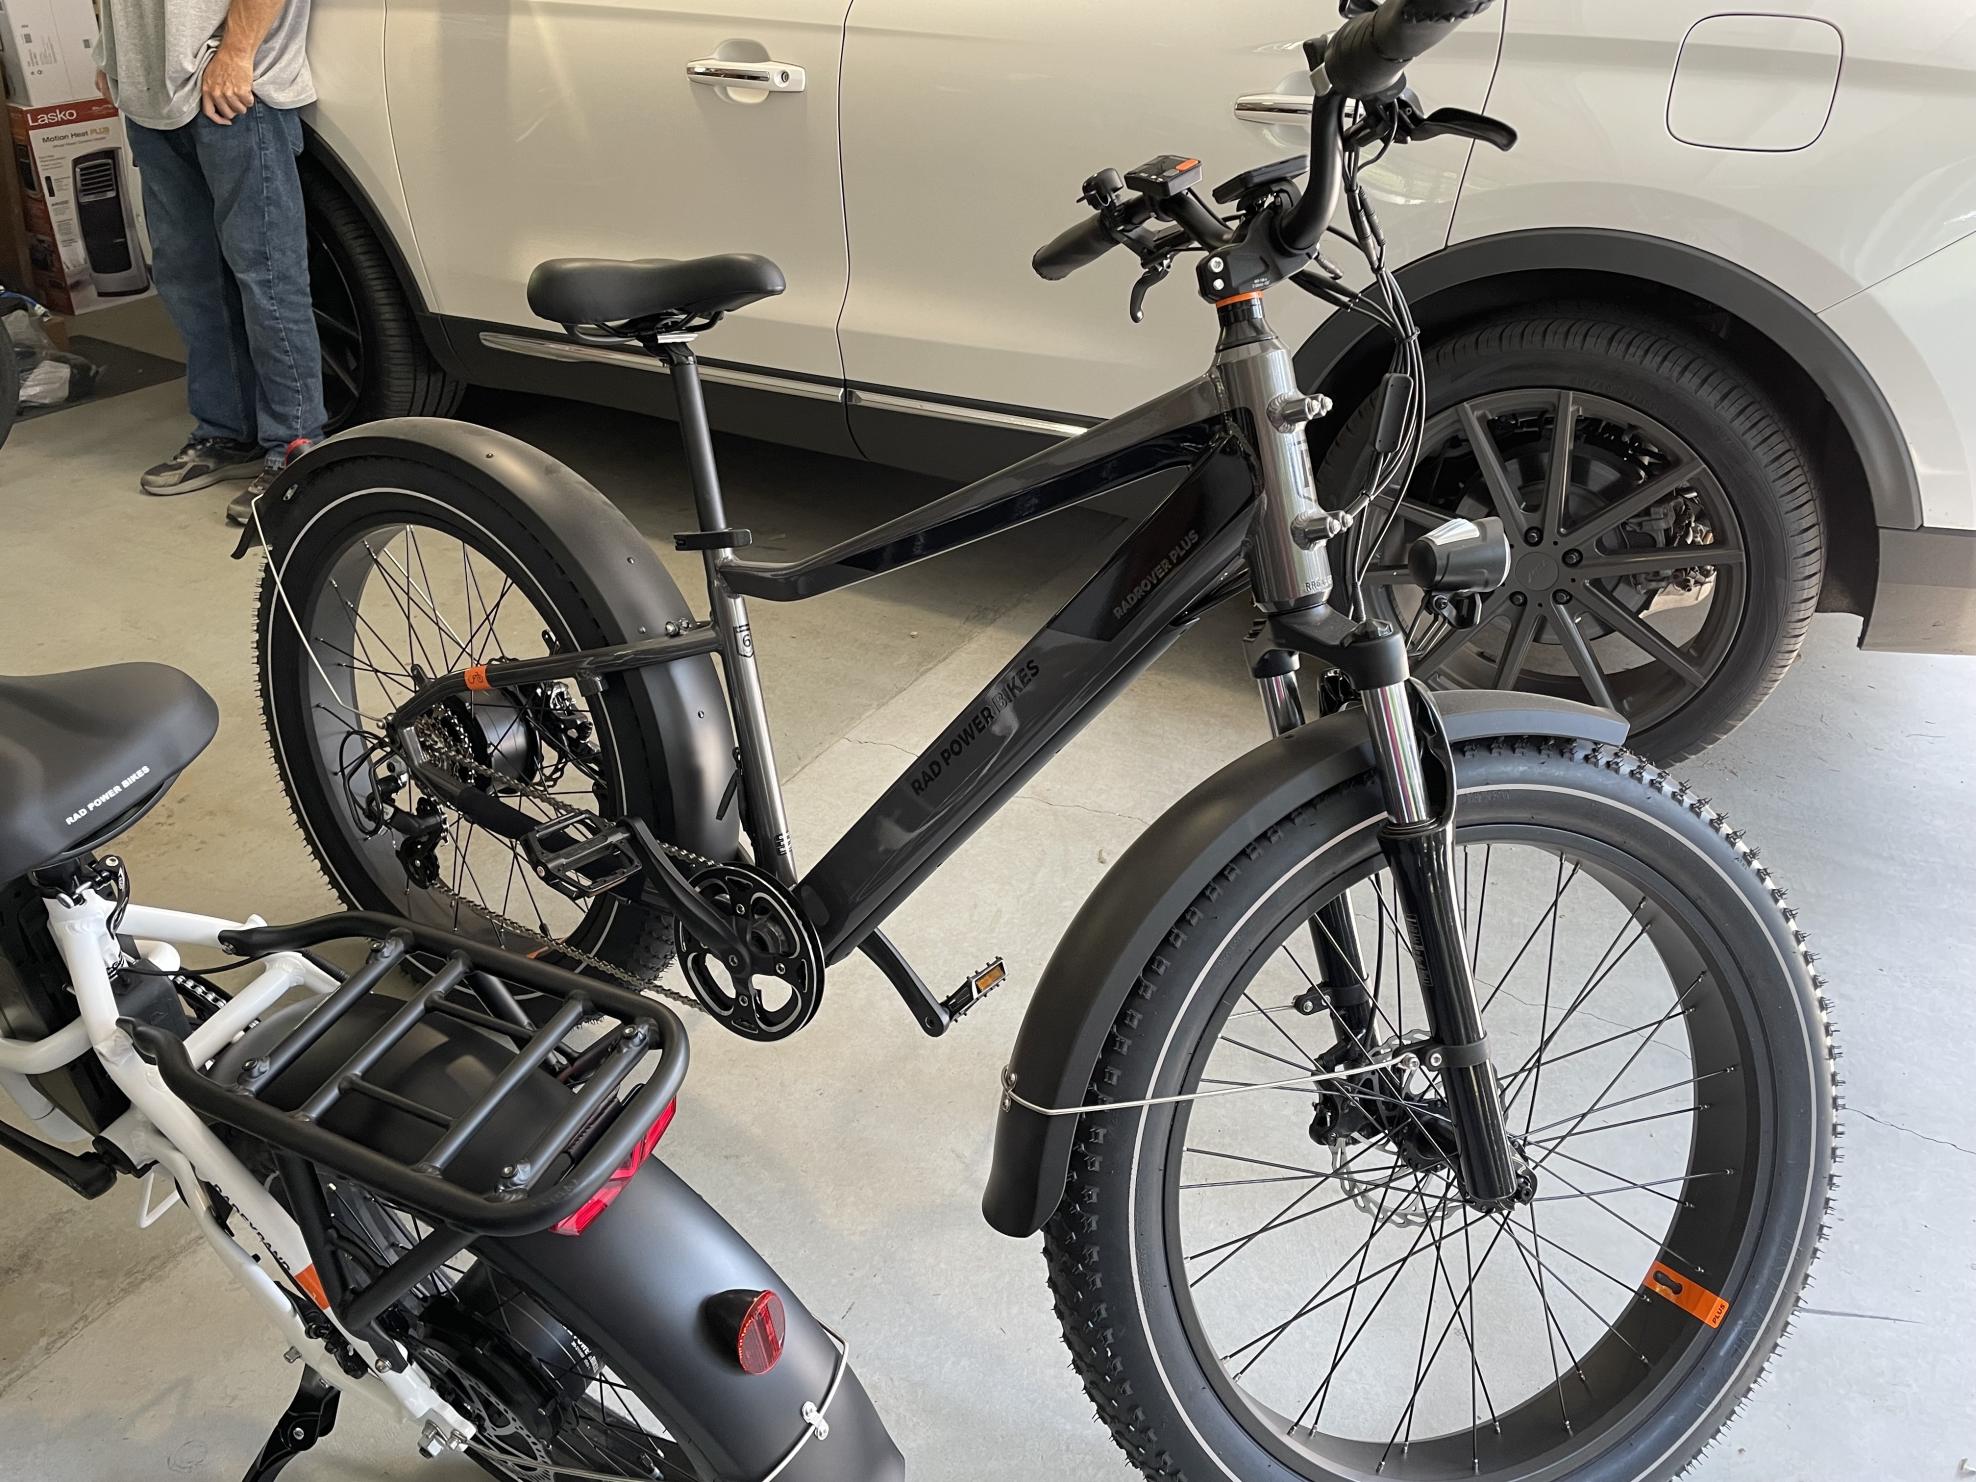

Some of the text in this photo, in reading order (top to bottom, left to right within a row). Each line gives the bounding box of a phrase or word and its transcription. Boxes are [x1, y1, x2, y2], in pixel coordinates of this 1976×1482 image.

[27, 109, 77, 126] Lasko
[42, 134, 70, 143] Motion
[70, 130, 89, 138] Heat
[1113, 529, 1199, 619] RADROVER PLUS
[743, 633, 751, 647] 6
[911, 659, 1039, 796] RAD POWER BIKES
[65, 765, 150, 825] RAD POWER BIKES
[1712, 1303, 1726, 1325] PLUS
